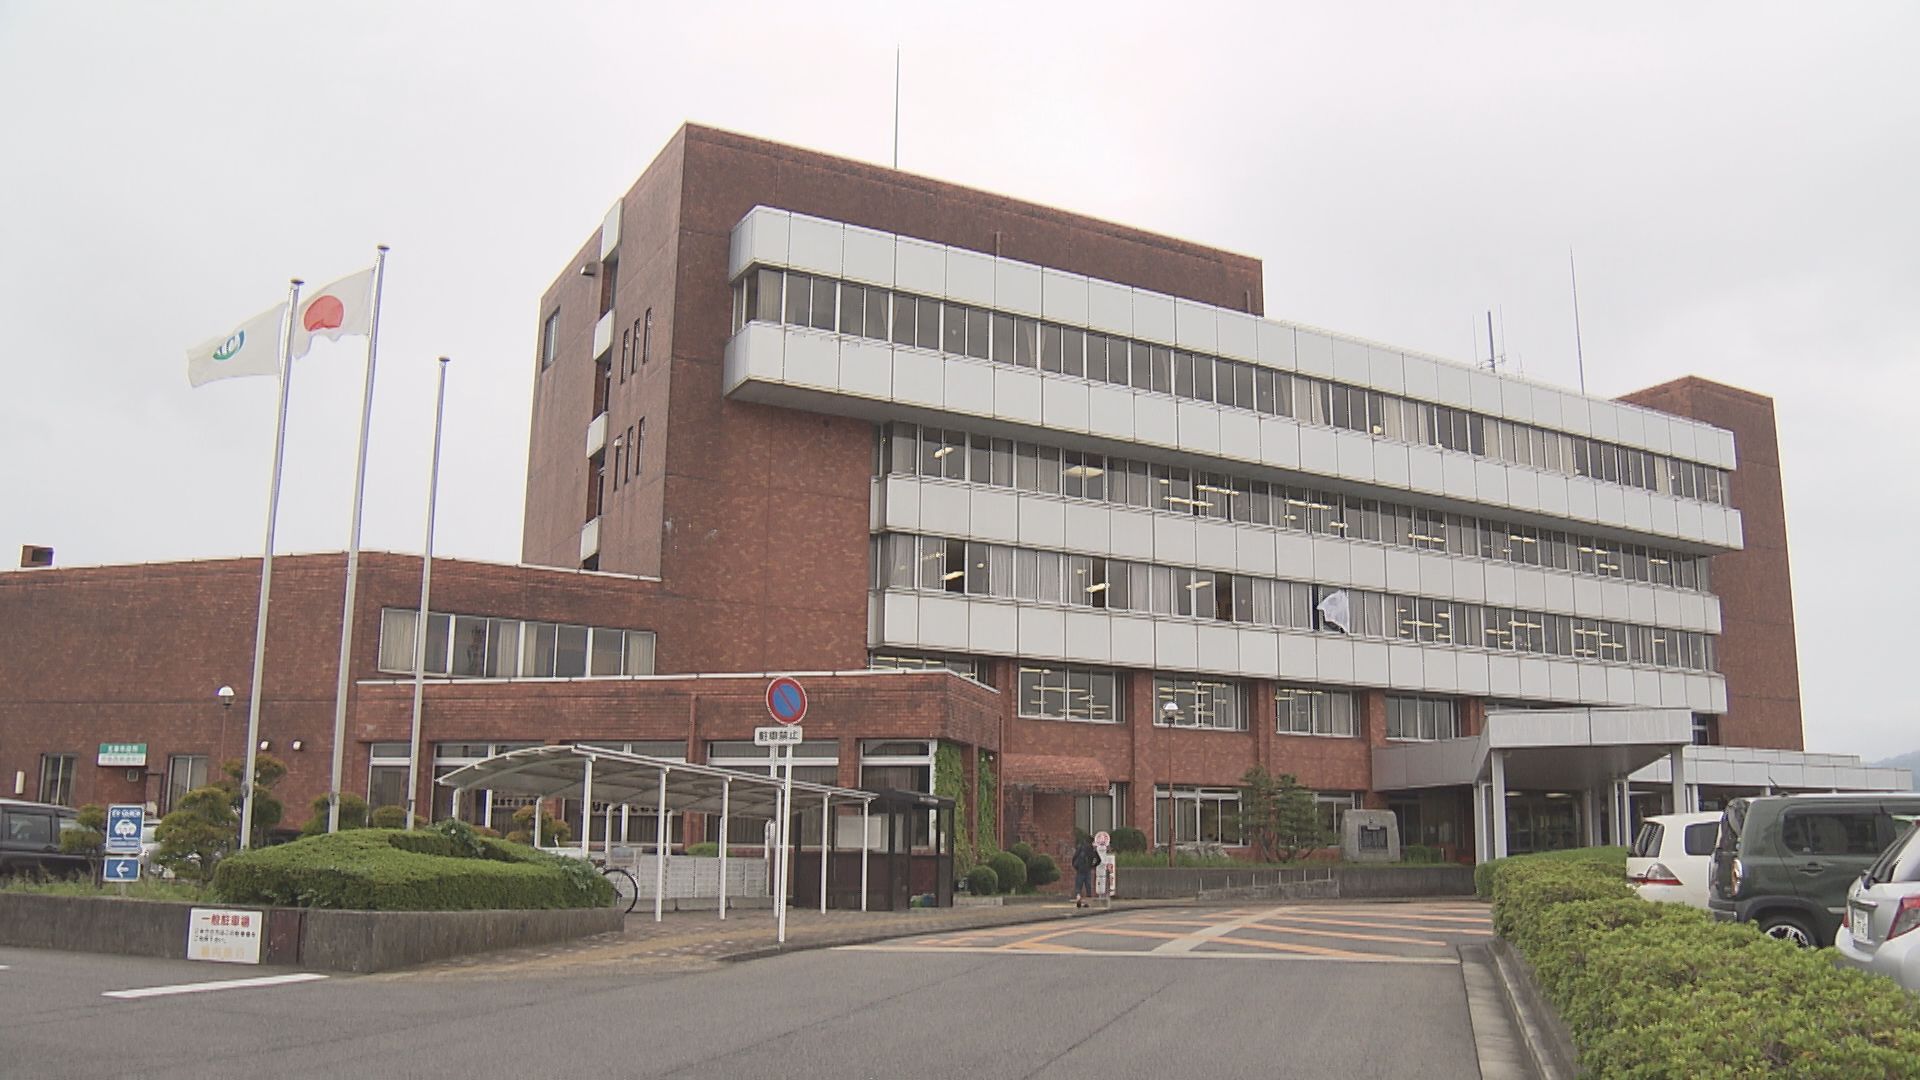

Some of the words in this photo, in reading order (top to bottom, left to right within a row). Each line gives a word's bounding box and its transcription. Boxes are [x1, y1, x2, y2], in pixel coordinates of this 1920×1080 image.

[758, 731, 799, 741] 駐車禁止
[201, 914, 249, 928] 一般駐車場
